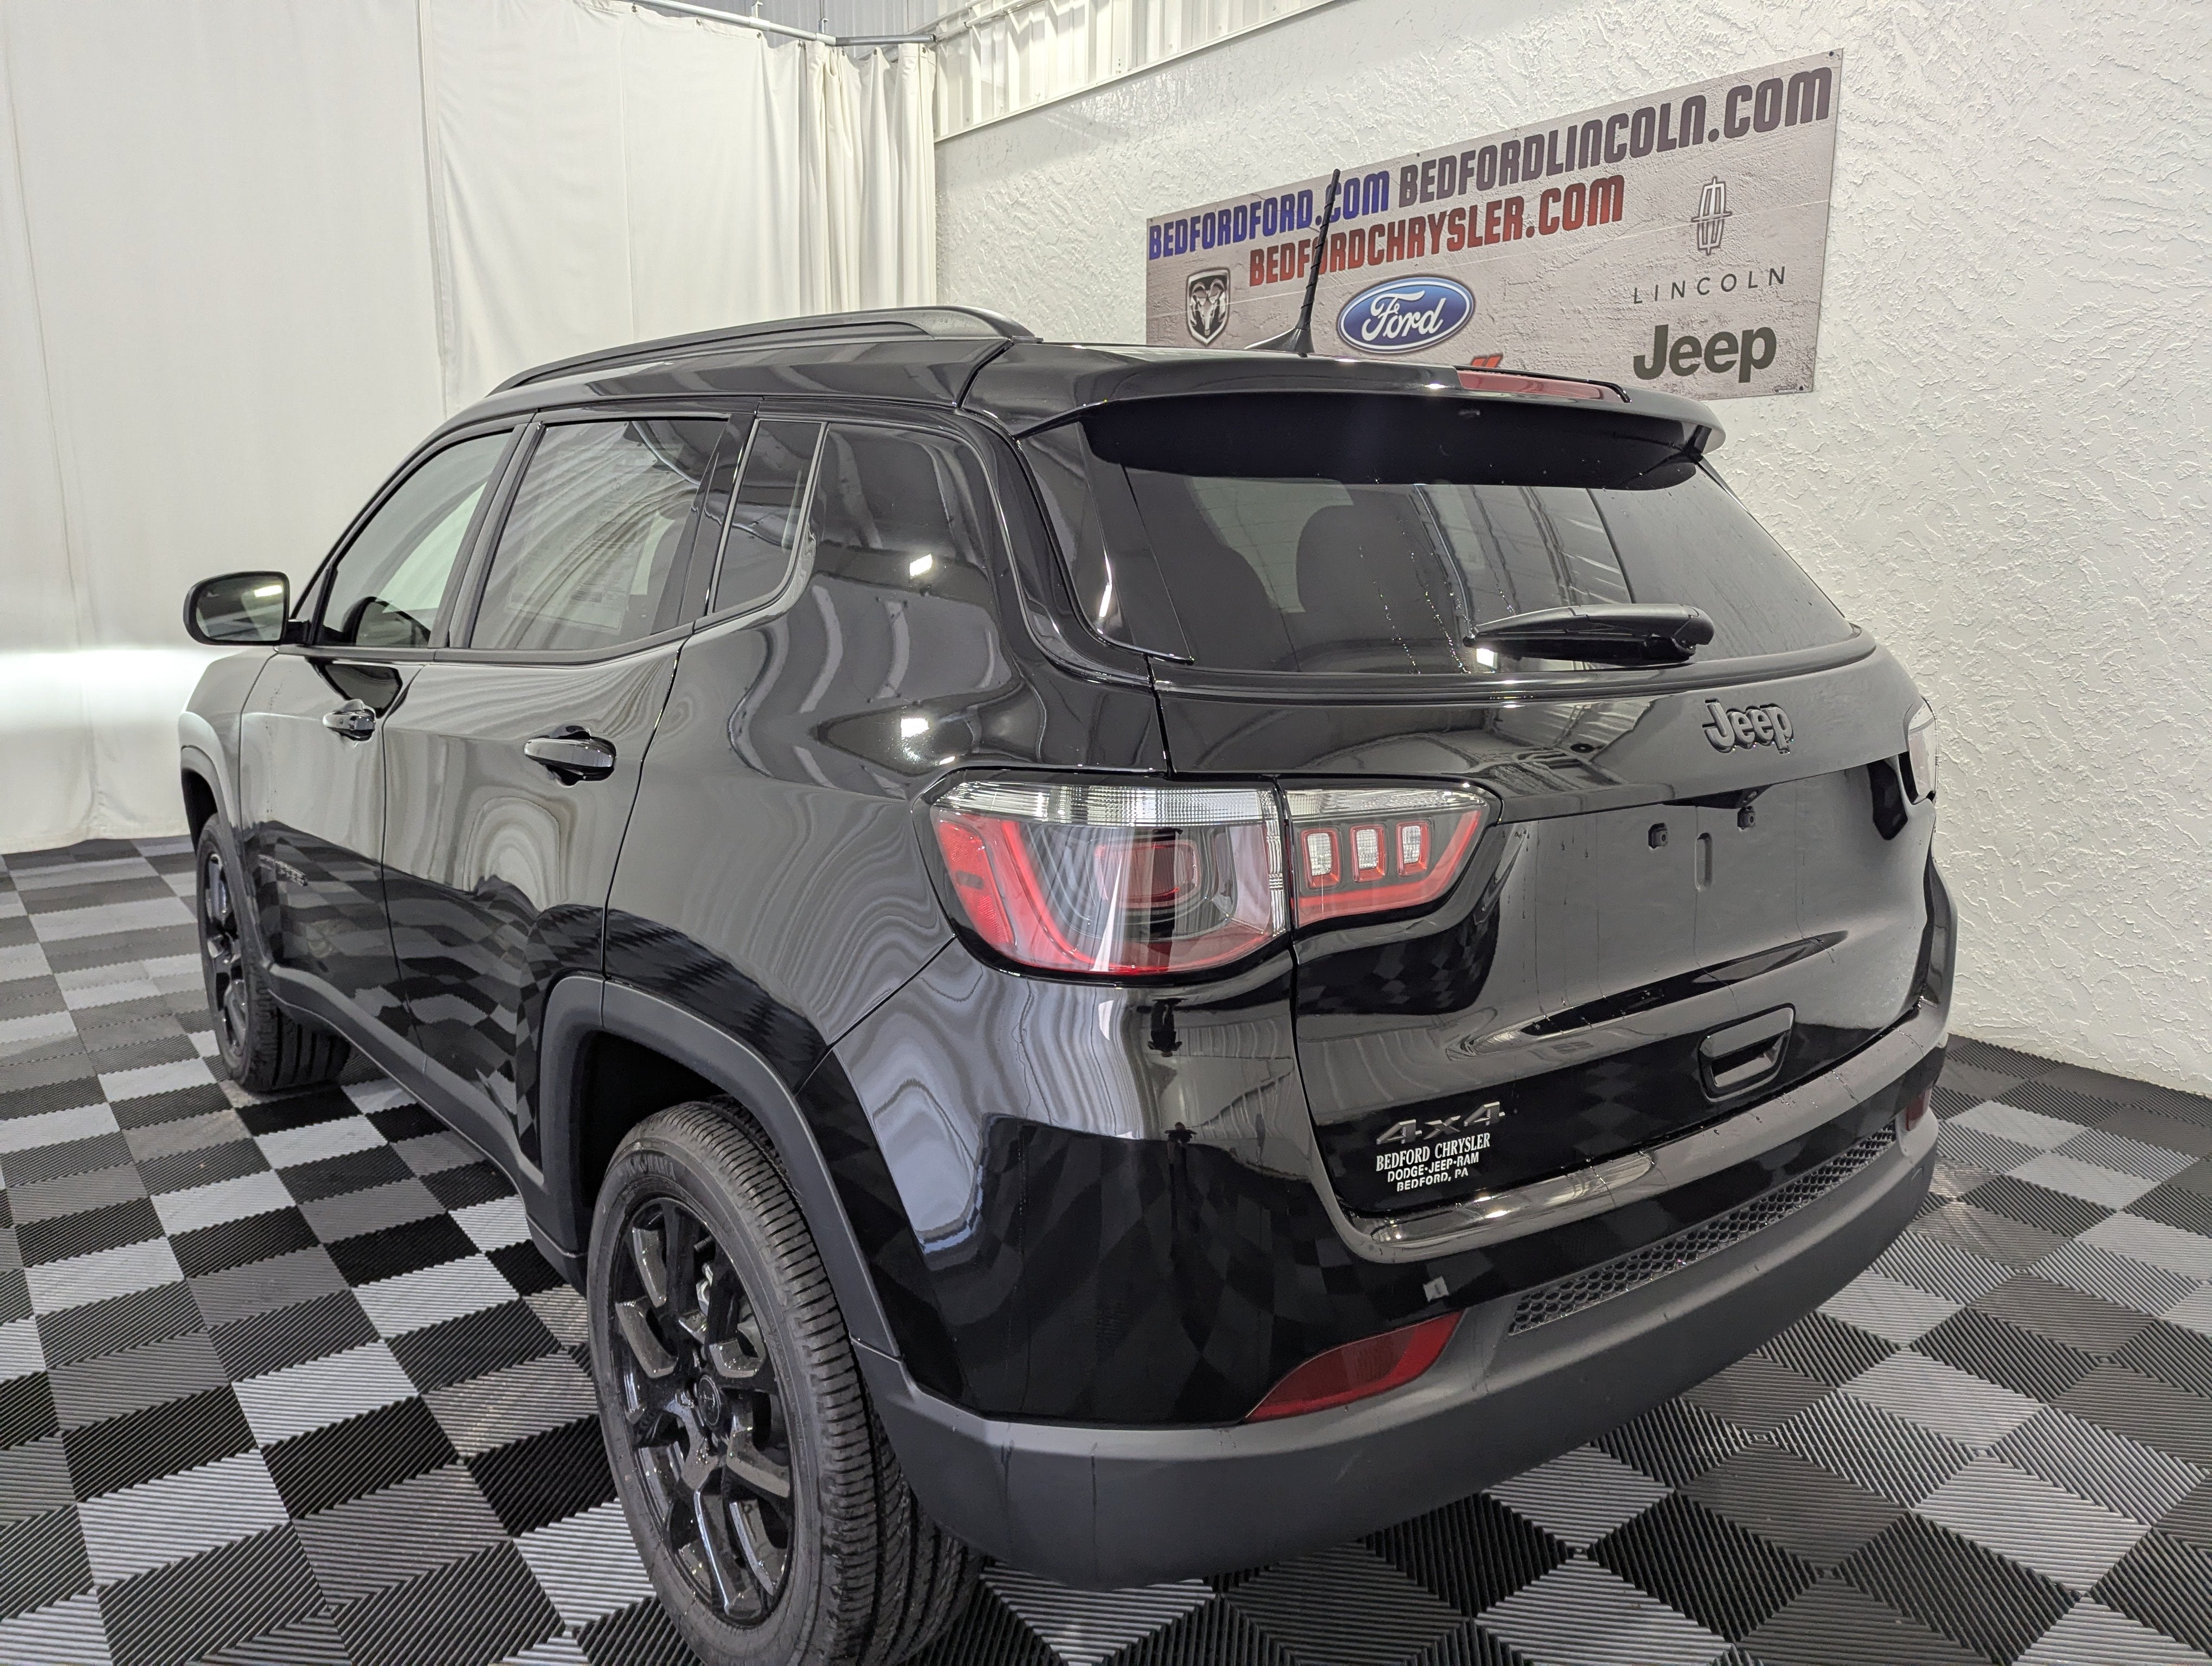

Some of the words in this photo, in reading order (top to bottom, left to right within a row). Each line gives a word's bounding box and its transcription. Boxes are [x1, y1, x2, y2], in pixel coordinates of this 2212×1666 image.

[1398, 66, 1832, 208] BEDFORDLINCOLN.COM
[1633, 266, 1785, 304] LINCOLN
[1361, 290, 1446, 341] Ford
[1632, 324, 1778, 384] Jeep
[1702, 699, 1794, 754] Jeep
[1375, 1145, 1430, 1171] BEDFORD
[1435, 1132, 1490, 1159] CHRYSLER
[1397, 1172, 1452, 1192] BEDFORD,
[1455, 1167, 1469, 1179] PA
